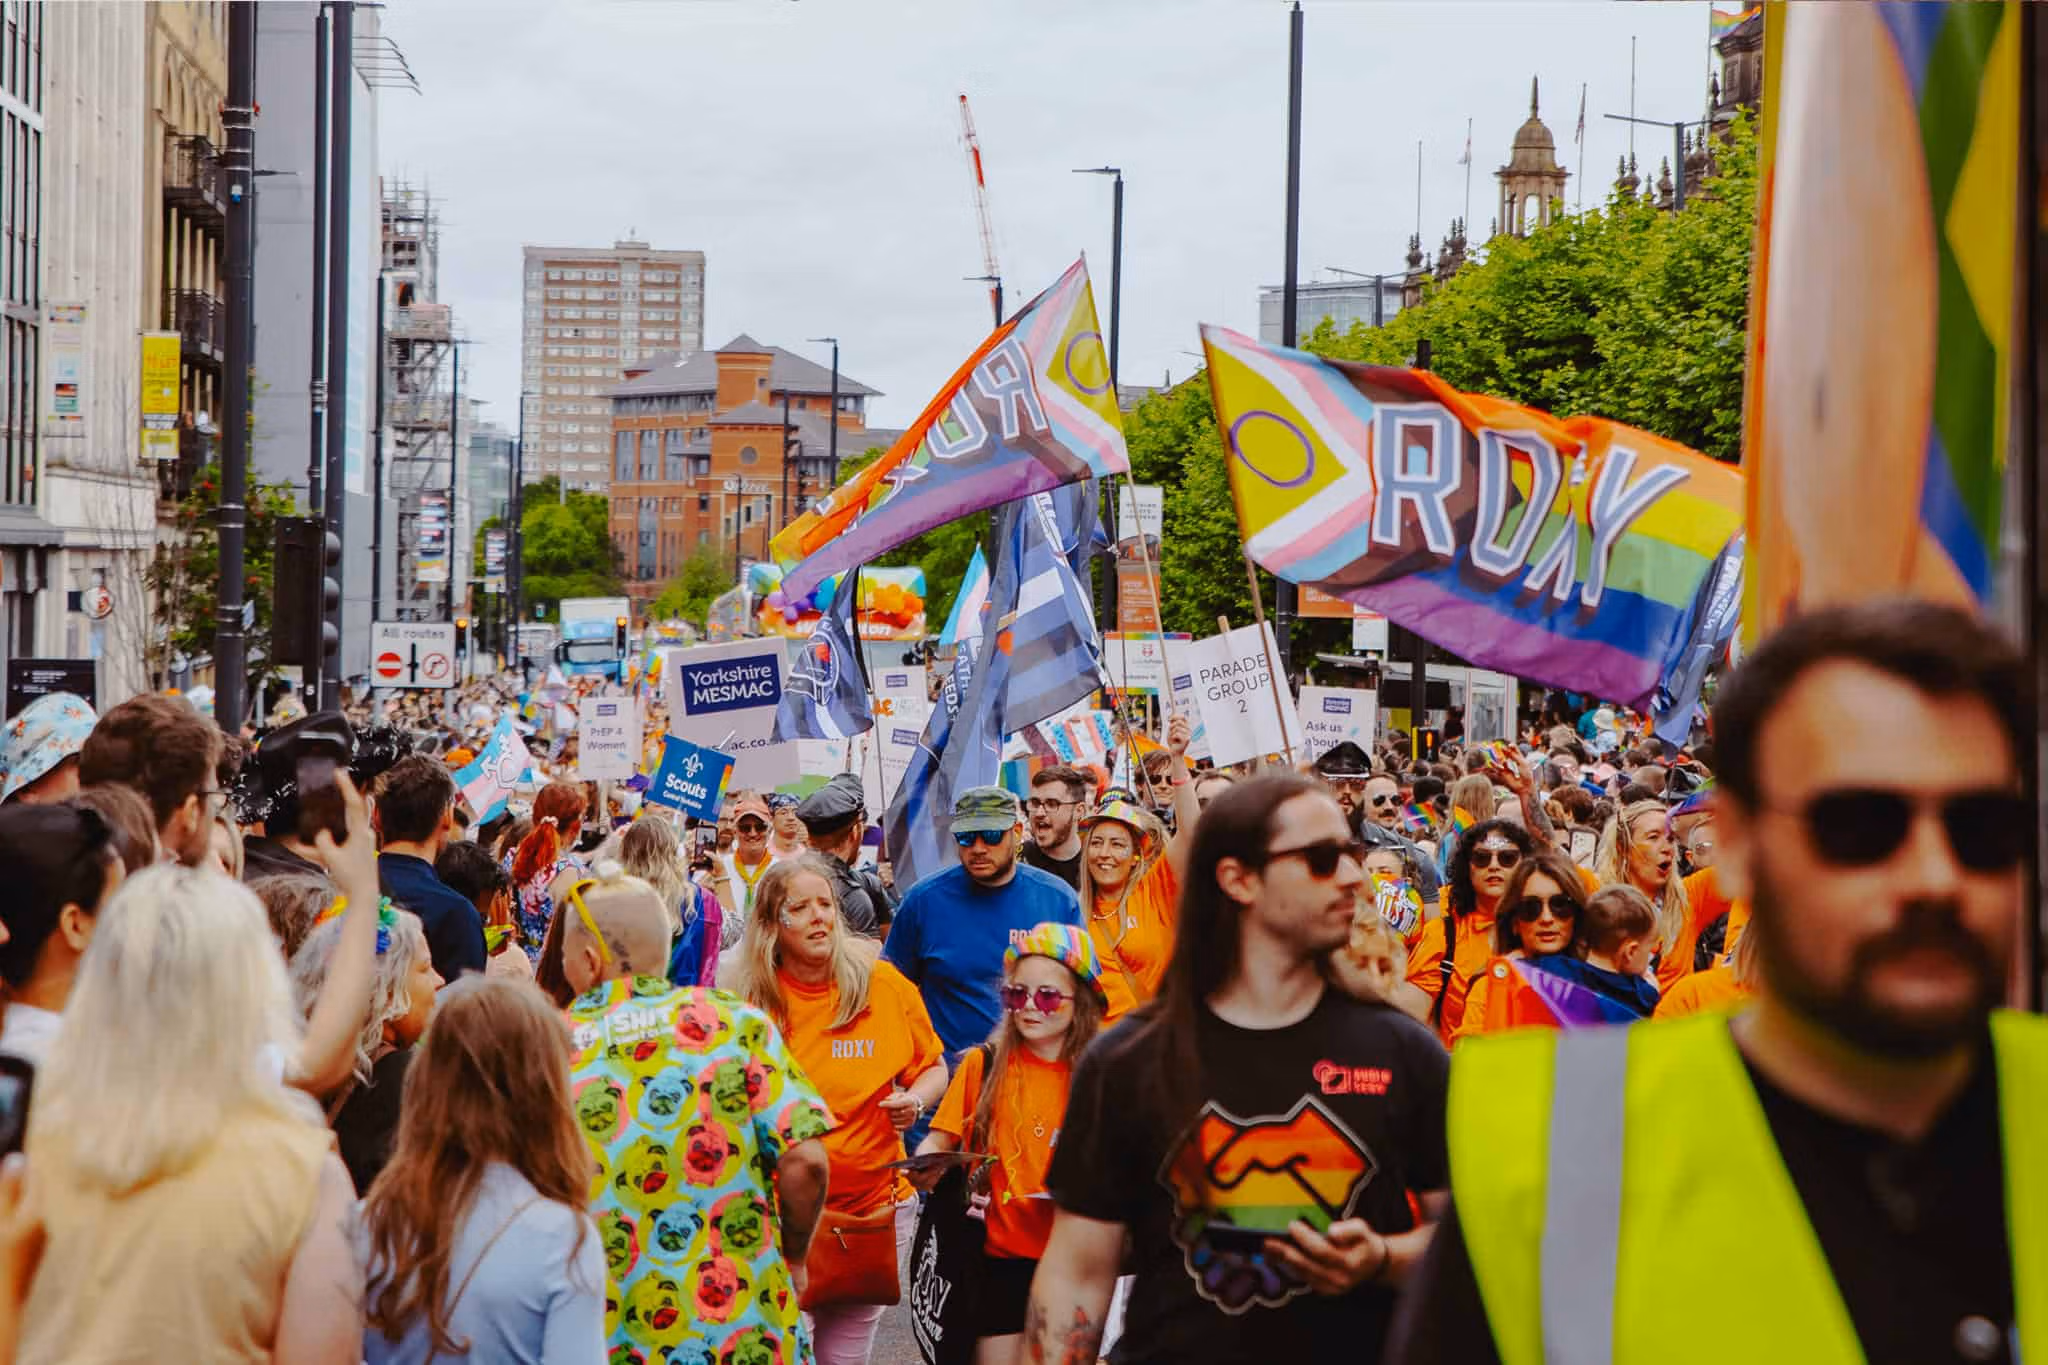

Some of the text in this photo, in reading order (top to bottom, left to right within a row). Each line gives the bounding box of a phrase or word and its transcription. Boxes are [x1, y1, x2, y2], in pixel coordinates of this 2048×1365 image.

[382, 627, 445, 639] All routes
[689, 664, 772, 687] Yorkshire
[1200, 653, 1267, 684] PARADE
[693, 680, 774, 706] MESMAC
[1207, 672, 1270, 701] GROUP
[1238, 699, 1248, 713] 2
[1305, 721, 1343, 732] Ask us
[587, 741, 626, 750] Women
[1304, 736, 1339, 747] about
[665, 773, 708, 799] Scouts
[1009, 929, 1033, 945] RO
[831, 1039, 876, 1058] ROXY
